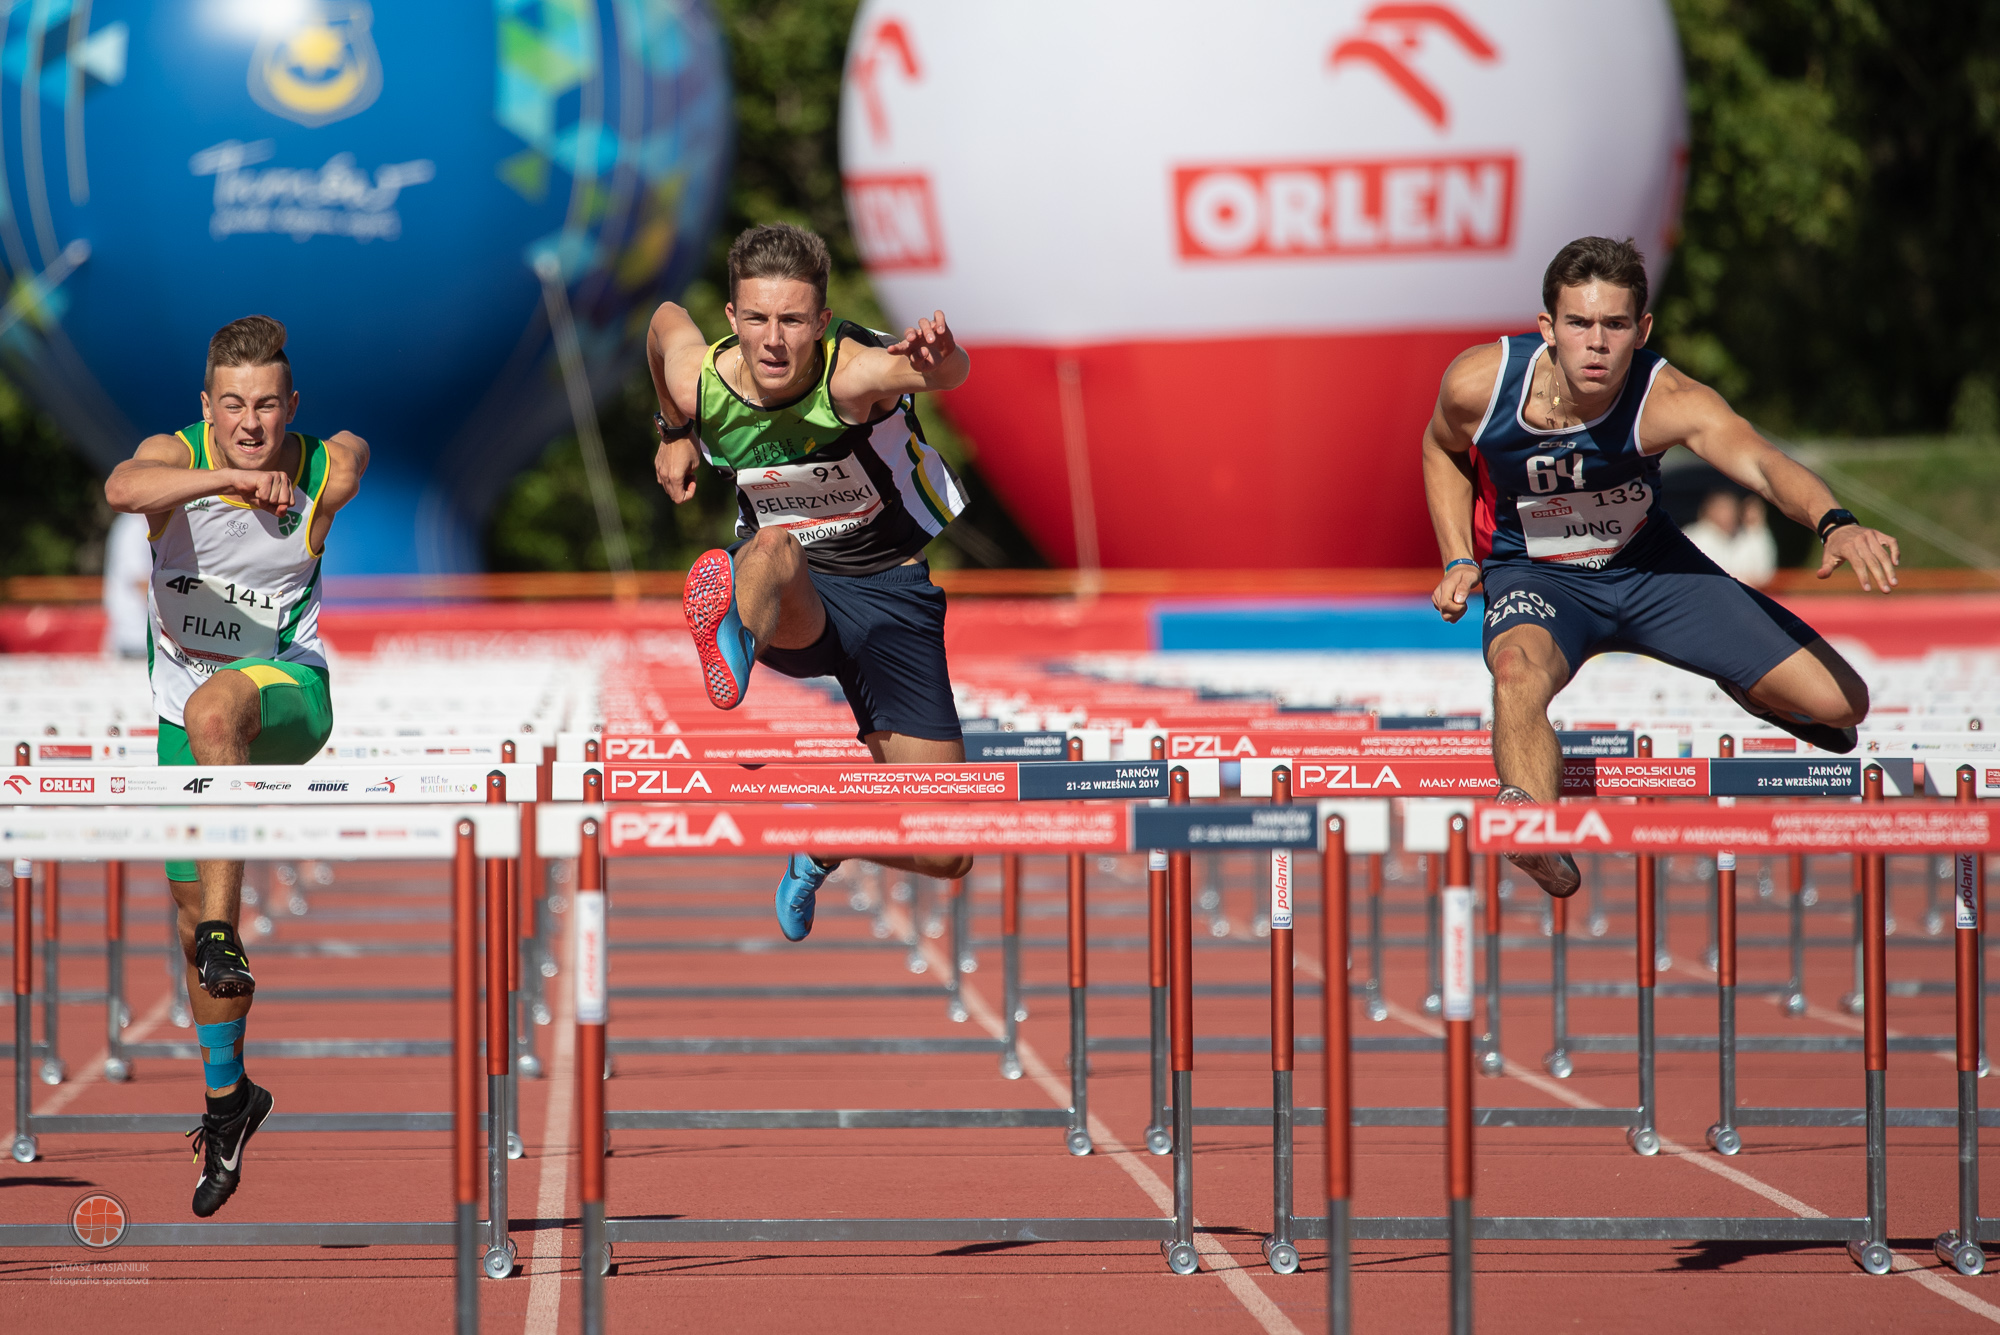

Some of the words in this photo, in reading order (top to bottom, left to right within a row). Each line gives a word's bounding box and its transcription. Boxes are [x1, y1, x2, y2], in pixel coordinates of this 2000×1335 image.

[1182, 163, 1504, 252] ORLEN
[752, 438, 793, 456] BIAŁE
[755, 447, 797, 464] BŁOTA
[812, 464, 850, 483] 91
[1526, 453, 1586, 494] 64
[752, 482, 788, 490] ORLEN
[1592, 481, 1646, 507] 133
[756, 484, 873, 515] SELERZYŃSKI
[1534, 508, 1570, 518] ORLEN
[799, 525, 837, 542] RNÓW
[841, 517, 869, 532] 2019
[1563, 519, 1622, 539] JUNG
[166, 575, 203, 595] 4F
[224, 583, 273, 610] 141
[182, 615, 241, 641] FILAR
[606, 738, 691, 760] PZLA
[794, 738, 859, 748] MISTRZOST
[1172, 735, 1257, 758] PZLA
[1361, 736, 1438, 746] MISTRZOSTWA
[1440, 736, 1479, 746] POLSKI
[1361, 746, 1412, 756] JANUSZA
[1414, 745, 1493, 756] KUSOCIŃSKIEG
[839, 772, 933, 783] MISTRZOSTWA
[935, 772, 981, 782] POLSKI
[983, 772, 1006, 782] U16
[1116, 766, 1159, 778] TARNÓW
[1300, 765, 1402, 789] PZLA
[1563, 766, 1623, 776] RZOSTWA
[1625, 766, 1671, 776] POLSKI
[1674, 766, 1696, 776] U16
[1808, 764, 1852, 776] TARNÓW
[42, 778, 92, 792] ORLEN
[183, 778, 214, 793] 4F
[420, 775, 440, 784] NESTLÉ
[611, 770, 713, 794] PZLA
[729, 783, 766, 794] MAŁY
[768, 783, 837, 794] MEMORIAŁ
[838, 784, 901, 794] JANUSZA
[903, 782, 1005, 794] KUSOCIŃSKIEGO
[1066, 781, 1092, 790] 21-22
[1094, 778, 1137, 790] WRZEŚNIA
[1139, 779, 1160, 789] 2019
[1419, 777, 1456, 788] MAŁY
[1458, 778, 1500, 788] MEMO
[1594, 776, 1696, 787] KUSOCIŃSKIEGO
[1758, 778, 1783, 787] 21-22
[1784, 775, 1828, 787] WRZEŚNIA
[1830, 777, 1852, 787] 2019
[610, 810, 745, 848] PZLA
[1480, 809, 1612, 844] PZLA
[1275, 853, 1290, 910] polanik
[1960, 853, 1975, 910] polanik
